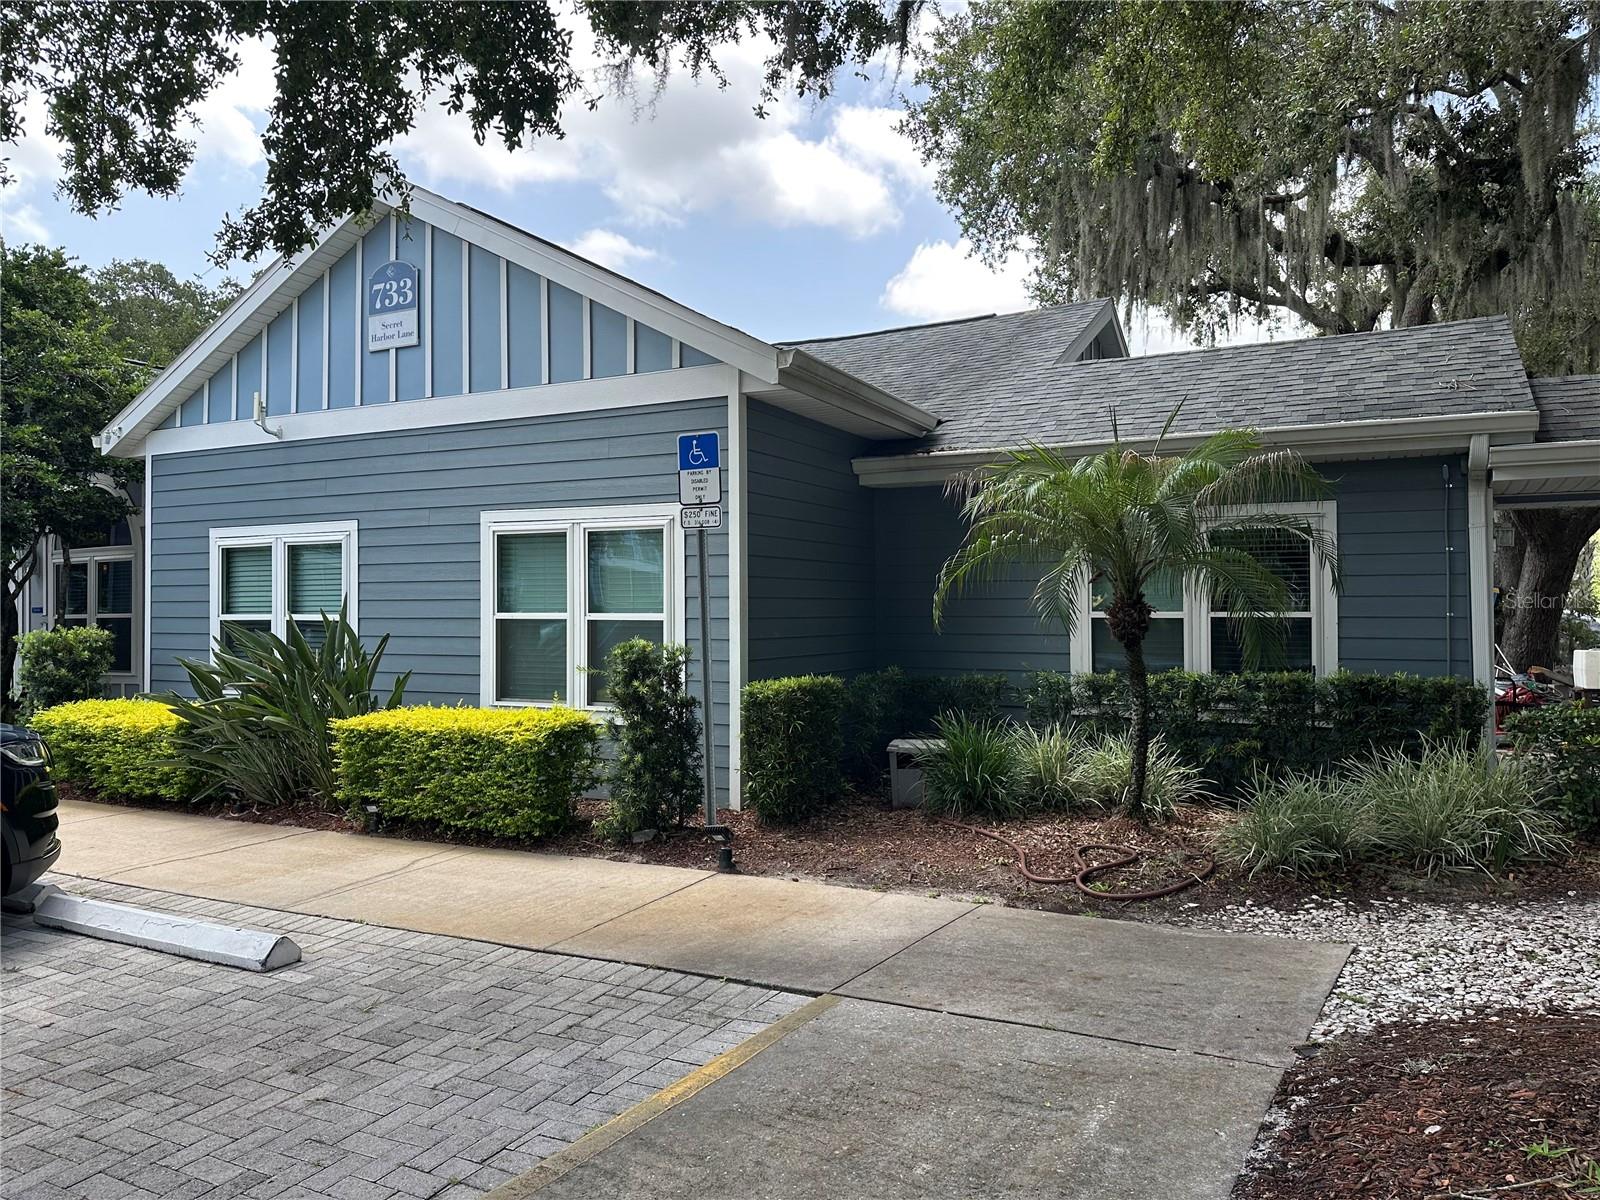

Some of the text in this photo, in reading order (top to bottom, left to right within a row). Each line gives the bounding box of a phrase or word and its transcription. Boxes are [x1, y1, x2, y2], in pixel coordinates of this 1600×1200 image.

[371, 278, 413, 309] 733
[381, 321, 403, 330] Secret
[371, 330, 414, 343] Harbor Lane
[683, 511, 701, 519] $250
